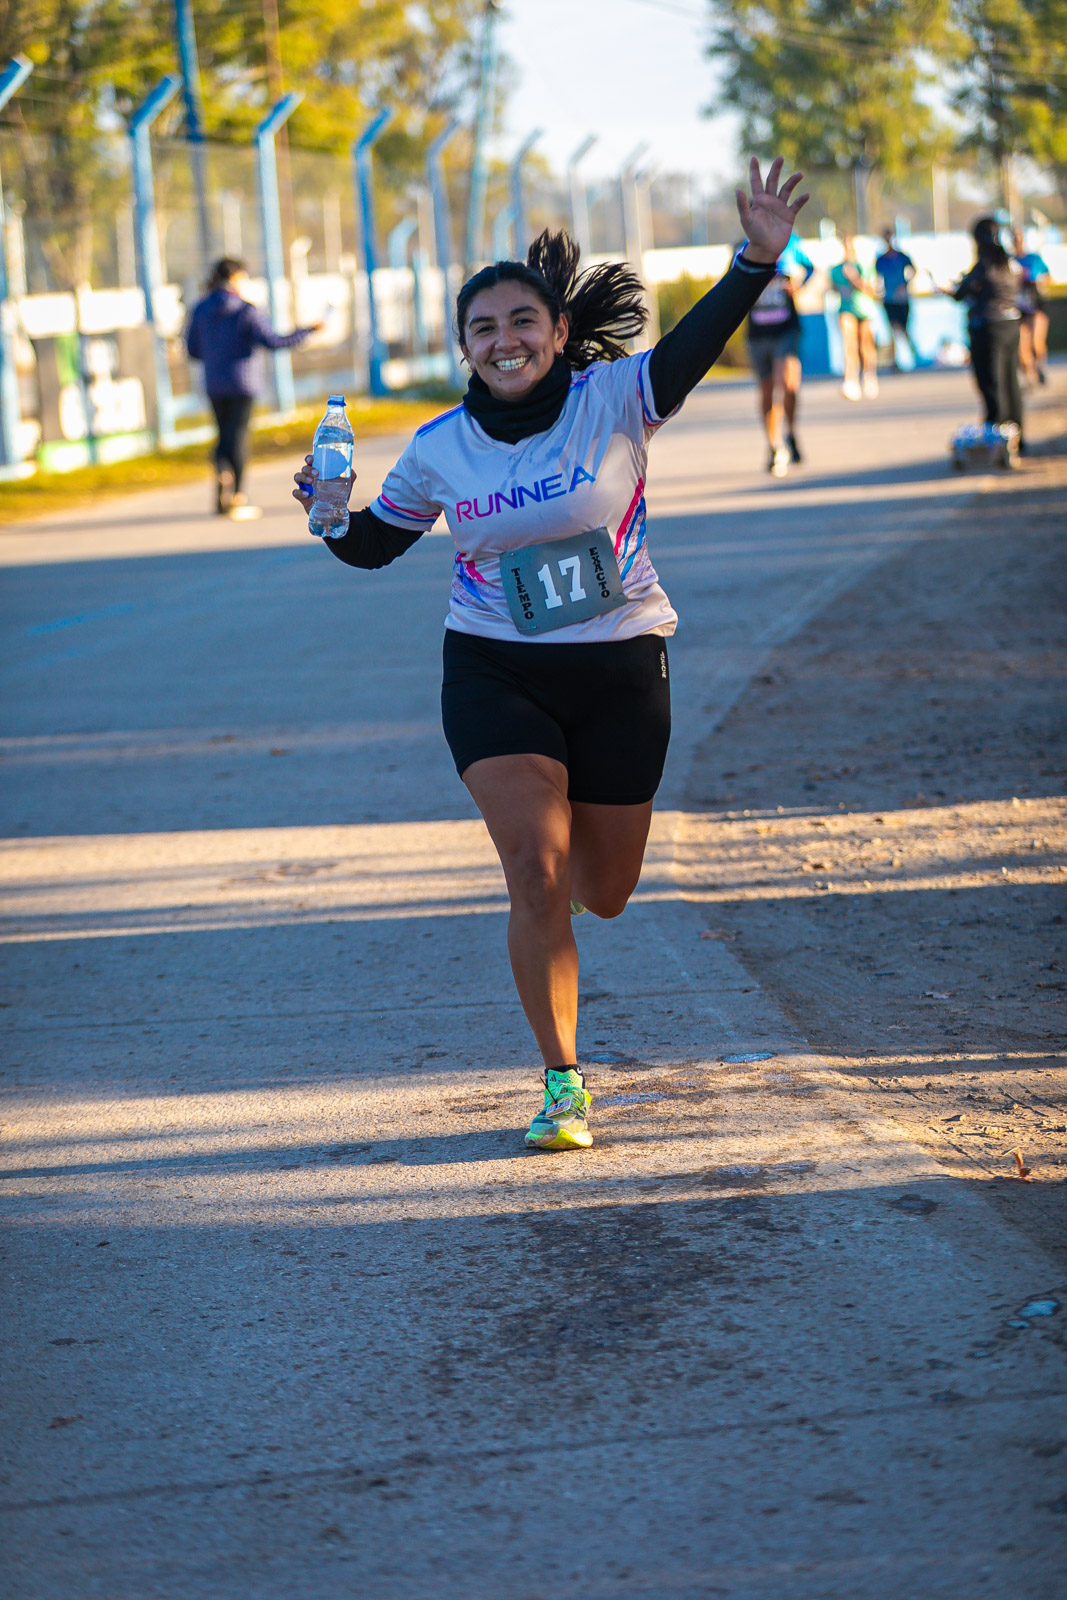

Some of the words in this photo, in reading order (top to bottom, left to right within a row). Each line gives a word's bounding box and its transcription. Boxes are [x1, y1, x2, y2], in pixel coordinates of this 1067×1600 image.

[456, 466, 596, 523] RUNNEA
[511, 567, 534, 620] TIEMPO
[537, 554, 587, 610] 17
[588, 546, 610, 598] EXACTO
